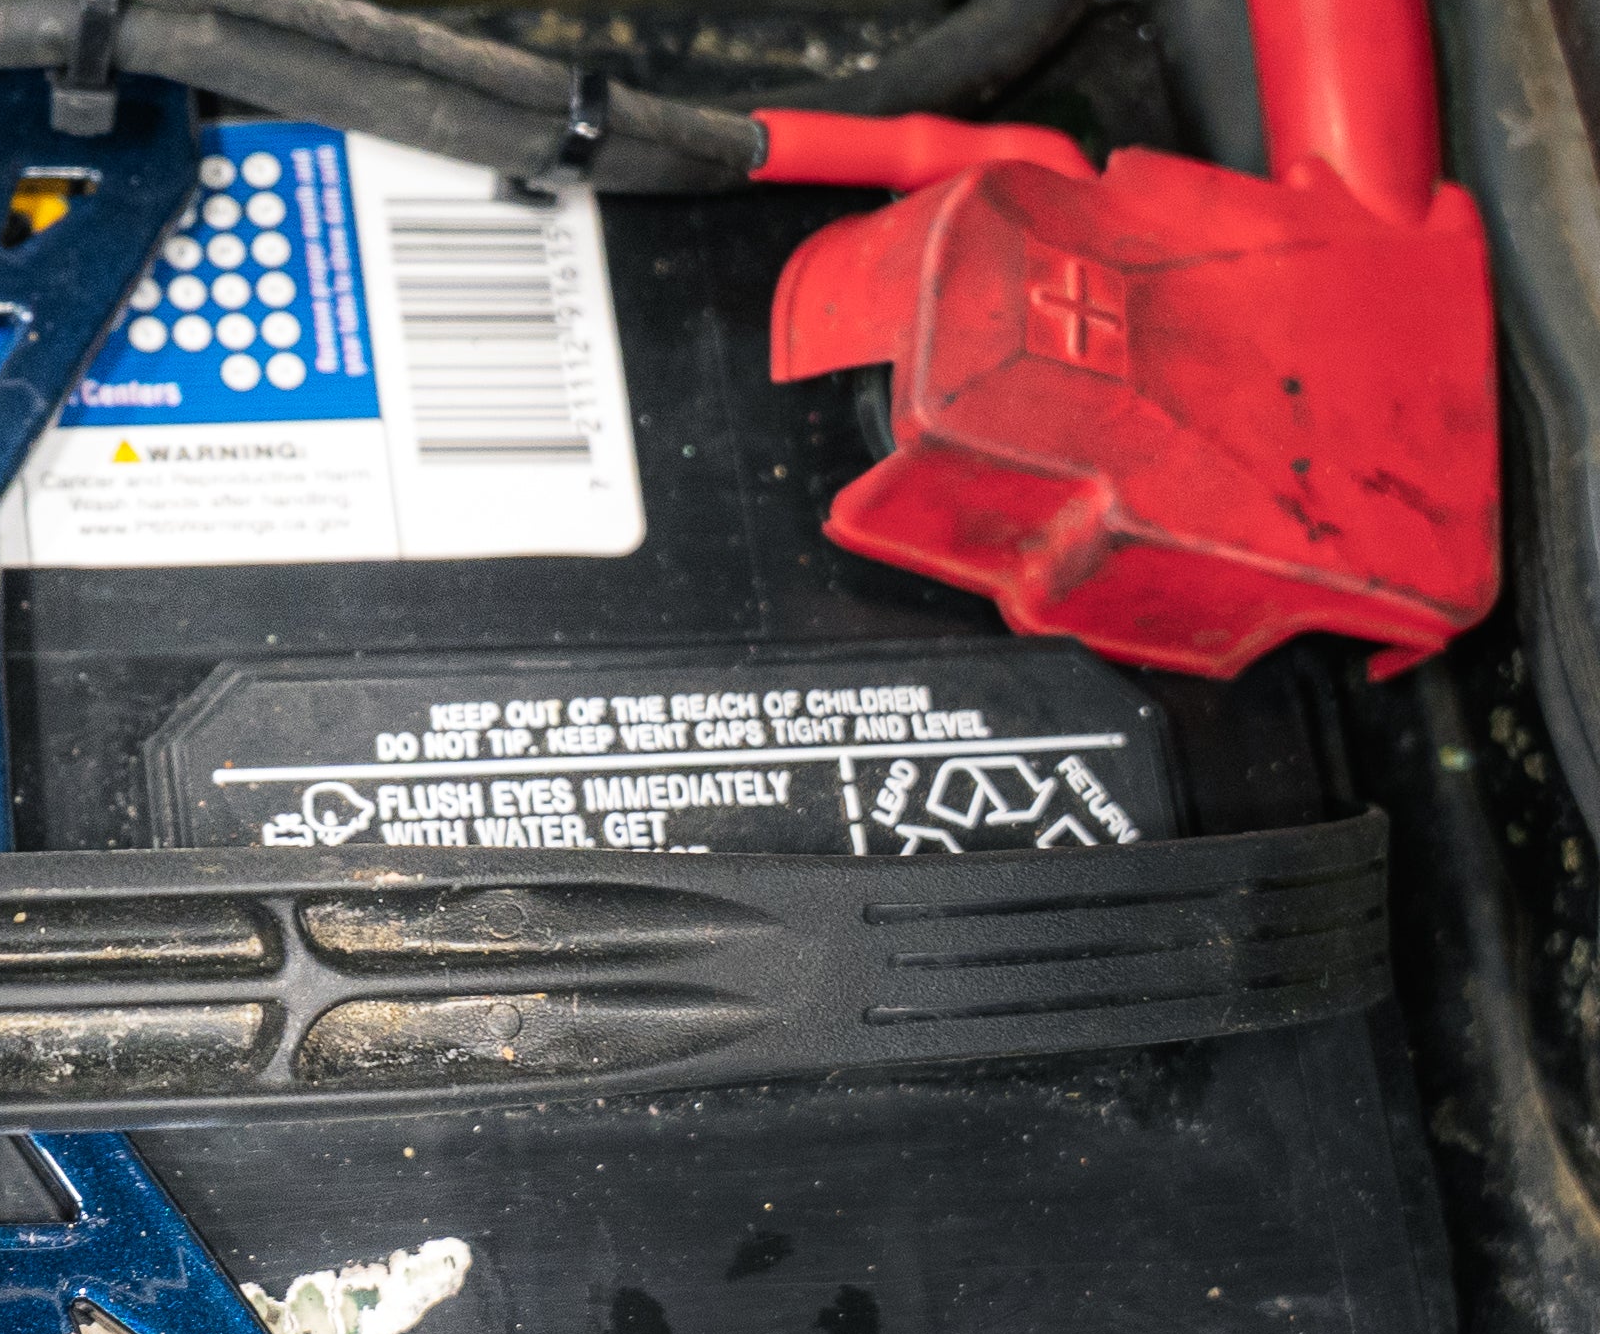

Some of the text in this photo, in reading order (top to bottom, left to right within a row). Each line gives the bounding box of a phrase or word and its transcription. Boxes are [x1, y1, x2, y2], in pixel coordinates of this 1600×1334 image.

[81, 377, 182, 407] Centers
[430, 685, 933, 731] KEEP OUT OF THE REACH OF CHILDREN
[376, 709, 992, 761] DO NOT TIP. KEEP VENT CAPS TIGHT AND LEVEL
[377, 770, 792, 821] FLUSH EYES IMMEDIATELY
[870, 758, 920, 828] LEAD
[1053, 754, 1143, 845] RETURN
[380, 818, 468, 847] WITH
[603, 811, 669, 849] GET
